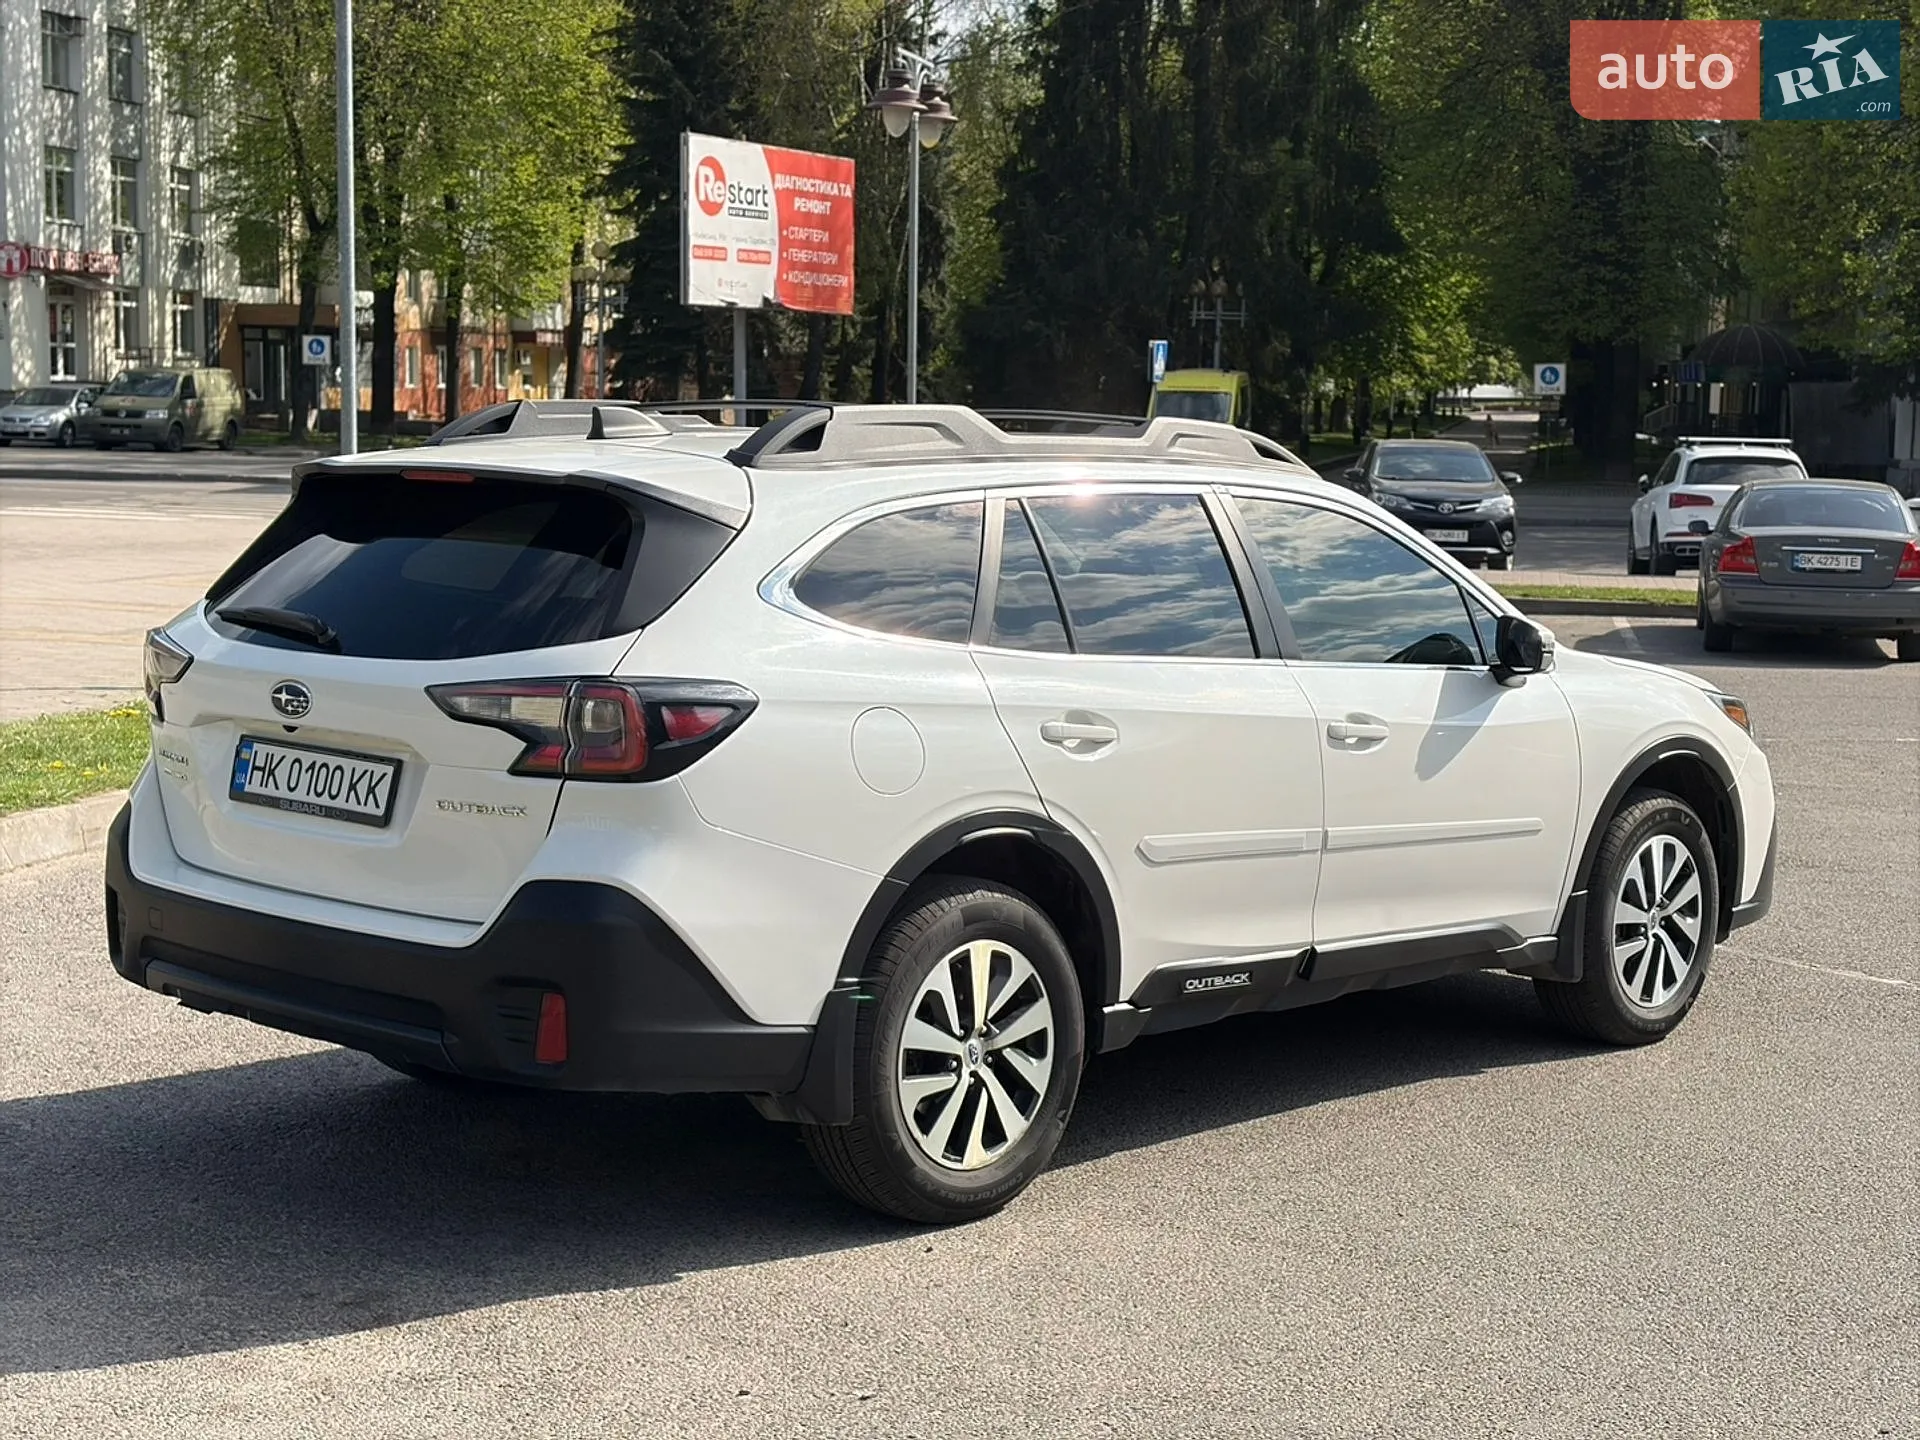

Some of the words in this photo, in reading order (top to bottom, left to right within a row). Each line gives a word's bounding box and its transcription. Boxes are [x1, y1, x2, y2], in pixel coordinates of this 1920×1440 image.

[774, 173, 839, 196] ДІАГНОСТИКА
[839, 183, 852, 198] ТА
[794, 197, 831, 215] РЕМОНТ
[788, 226, 829, 243] СТАРТЕРИ
[788, 248, 838, 265] ГЕНЕРАТОРИ
[1800, 554, 1814, 566] BK
[1817, 555, 1840, 567] 4275
[249, 750, 286, 790] HK
[287, 757, 344, 800] 0100
[345, 767, 388, 809] KK
[280, 799, 326, 817] SUBARU
[437, 799, 528, 817] OUTBACK
[1185, 972, 1251, 990] OUTBACK
